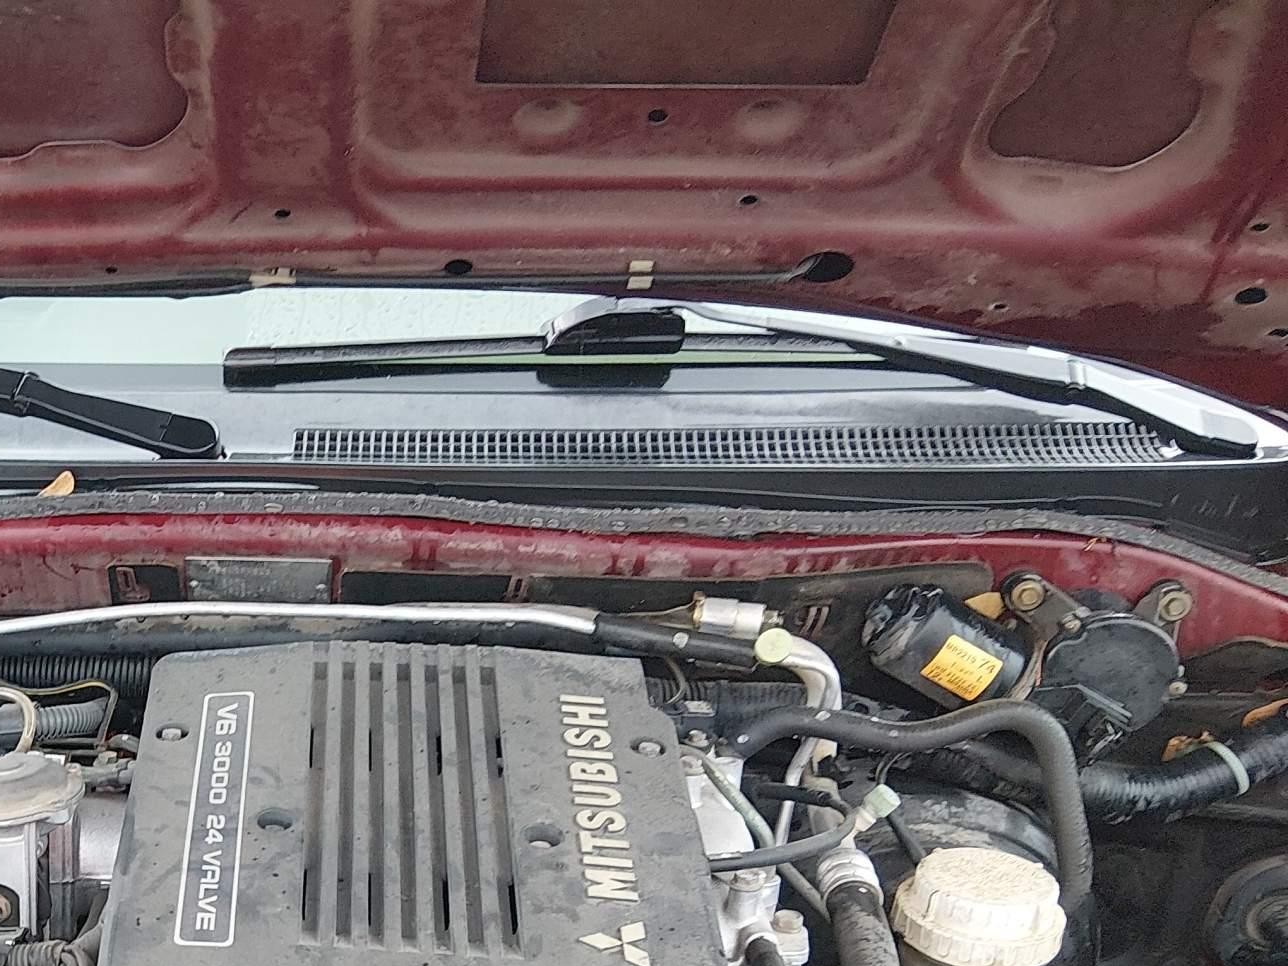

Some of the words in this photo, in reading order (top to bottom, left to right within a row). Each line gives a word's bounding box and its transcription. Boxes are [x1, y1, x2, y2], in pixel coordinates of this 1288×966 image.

[215, 702, 239, 735] V6
[209, 740, 232, 805] 3000
[560, 694, 640, 902] MITSUBISHI
[204, 814, 226, 845] 24
[195, 850, 223, 931] VALVE
